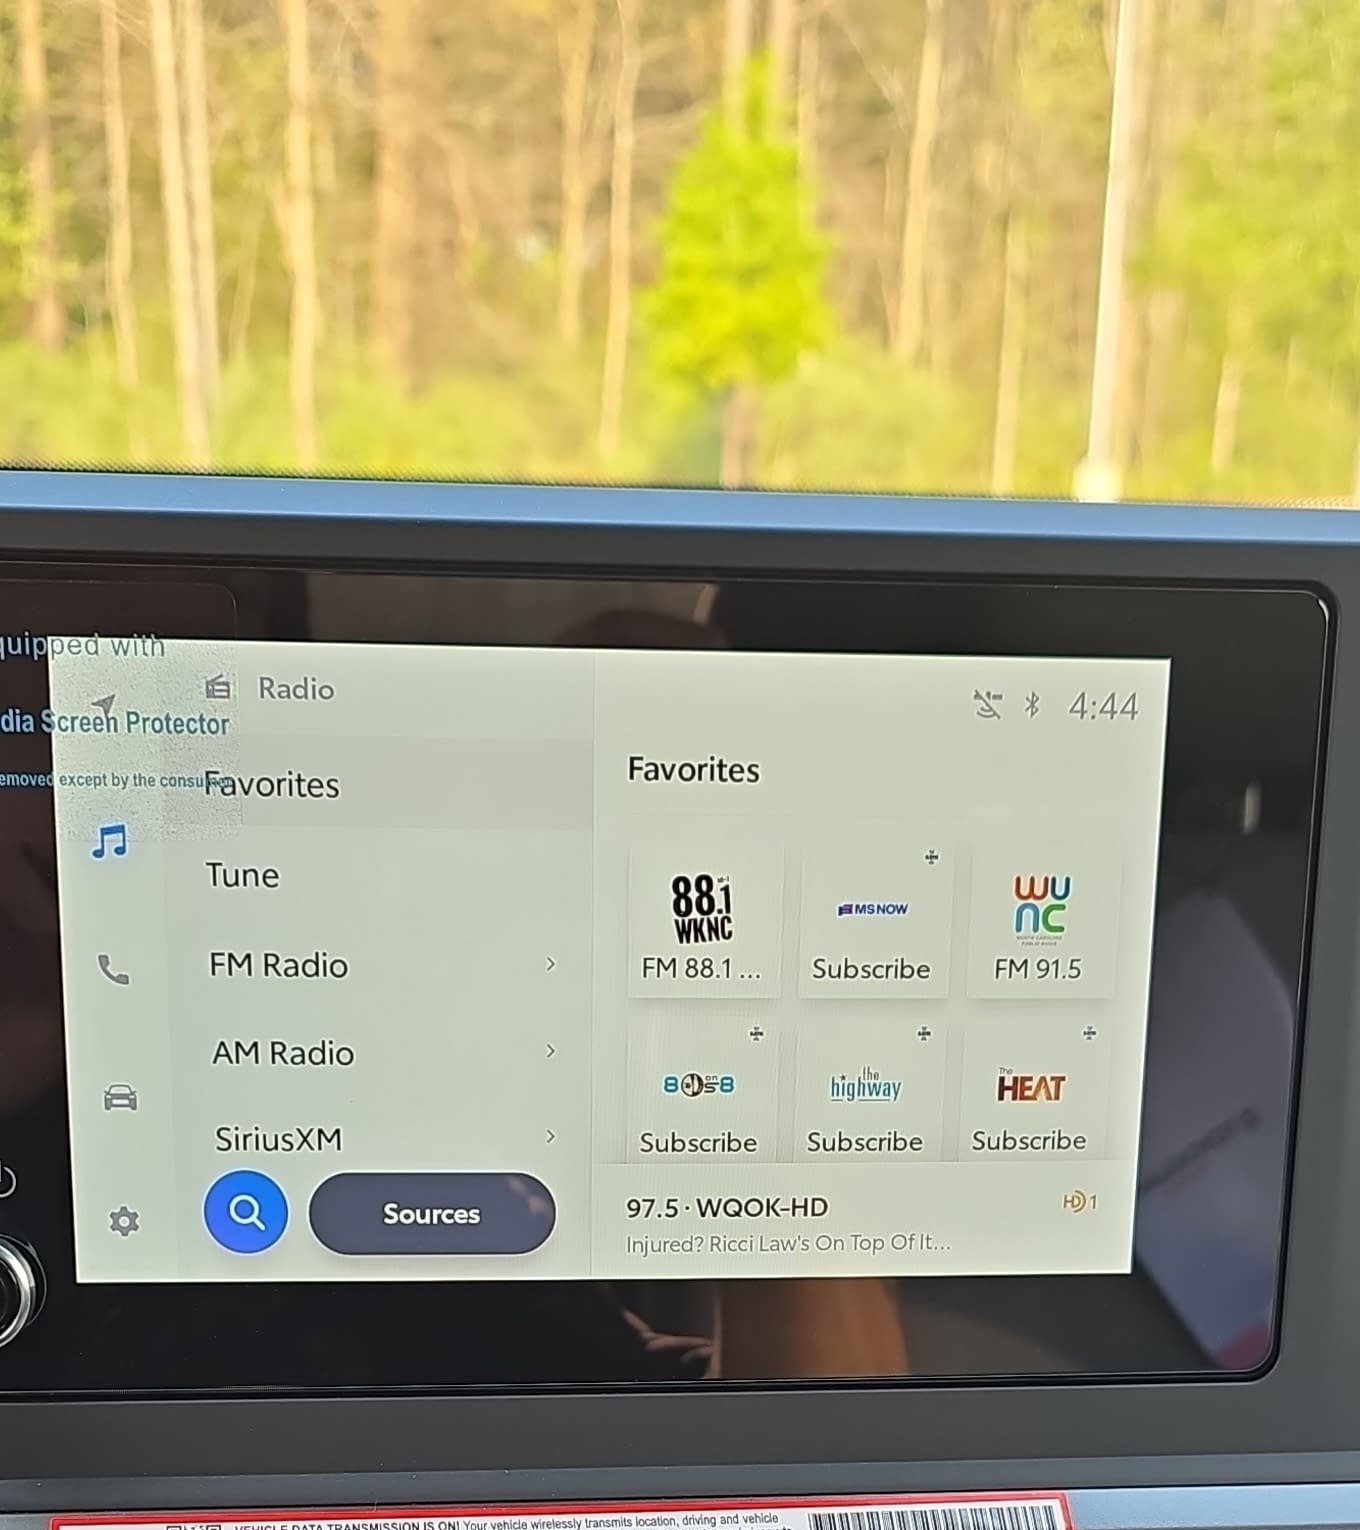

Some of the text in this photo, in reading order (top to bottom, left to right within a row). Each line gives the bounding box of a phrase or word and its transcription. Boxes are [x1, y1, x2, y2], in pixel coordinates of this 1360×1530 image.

[111, 633, 165, 657] with
[258, 676, 335, 702] Radio
[1069, 691, 1139, 721] 4:44
[40, 709, 119, 734] Screen
[126, 710, 230, 735] Protector
[59, 773, 108, 790] except
[111, 773, 129, 790] by
[133, 772, 156, 788] the
[627, 755, 761, 784] Favorites
[204, 770, 340, 799] Favorites
[206, 862, 280, 889] Tune
[671, 874, 731, 918] 88.1
[673, 915, 733, 945] WKNC
[209, 950, 350, 980] FM Radio
[642, 958, 678, 980] FM
[684, 958, 733, 980] 88.1
[812, 957, 931, 981] Subscribe
[994, 958, 1082, 980] FM 91.5
[211, 1039, 356, 1068] AM Radio
[862, 1066, 880, 1081] the
[831, 1073, 902, 1101] highway
[997, 1075, 1066, 1101] HEAT
[214, 1126, 344, 1154] SiriusXM
[639, 1131, 758, 1154] Subscribe
[806, 1131, 924, 1153] Subscribe
[971, 1130, 1087, 1152] Subscribe
[382, 1202, 481, 1227] Sources
[626, 1196, 829, 1219] 97.5 WQOK-HD
[626, 1235, 705, 1258] Injured?
[709, 1234, 754, 1253] Ricci
[759, 1234, 810, 1252] Law's
[815, 1233, 845, 1252] On
[850, 1233, 885, 1256] Top
[891, 1232, 915, 1251] Of
[490, 1518, 528, 1530] vehicle
[531, 1517, 582, 1530] wirelessly
[585, 1515, 633, 1528] transmits
[635, 1514, 680, 1528] location,
[681, 1513, 717, 1528] driving
[719, 1513, 740, 1525] and
[742, 1512, 779, 1524] vehicle
